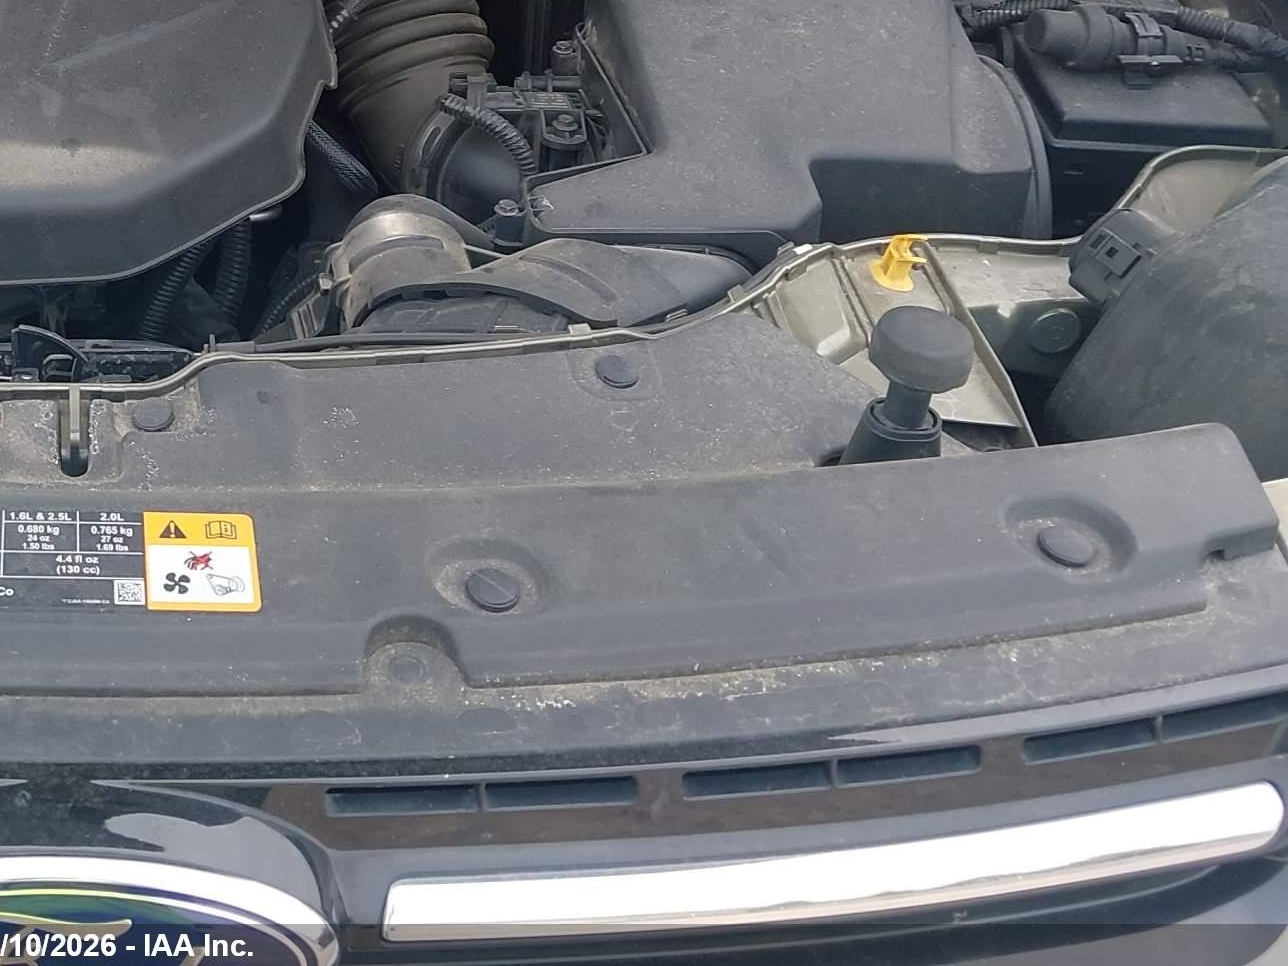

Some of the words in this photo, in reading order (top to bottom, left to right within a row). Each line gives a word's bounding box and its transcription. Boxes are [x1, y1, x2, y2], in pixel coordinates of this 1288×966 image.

[9, 511, 33, 521] 1.6L
[36, 512, 45, 521] &
[47, 512, 72, 521] 2.5L
[100, 512, 125, 522] 2.0L
[17, 524, 44, 534] 0.680
[46, 524, 60, 536] kg
[90, 525, 118, 535] 0.765
[119, 525, 133, 537] kg
[27, 534, 38, 542] 24
[100, 535, 112, 543] 27
[41, 542, 55, 550] lbs
[115, 543, 129, 551] lbs
[55, 554, 73, 564] 4.4
[74, 554, 83, 563] fl
[85, 556, 100, 564] oz
[56, 565, 81, 575] (130
[82, 565, 100, 575] cc)
